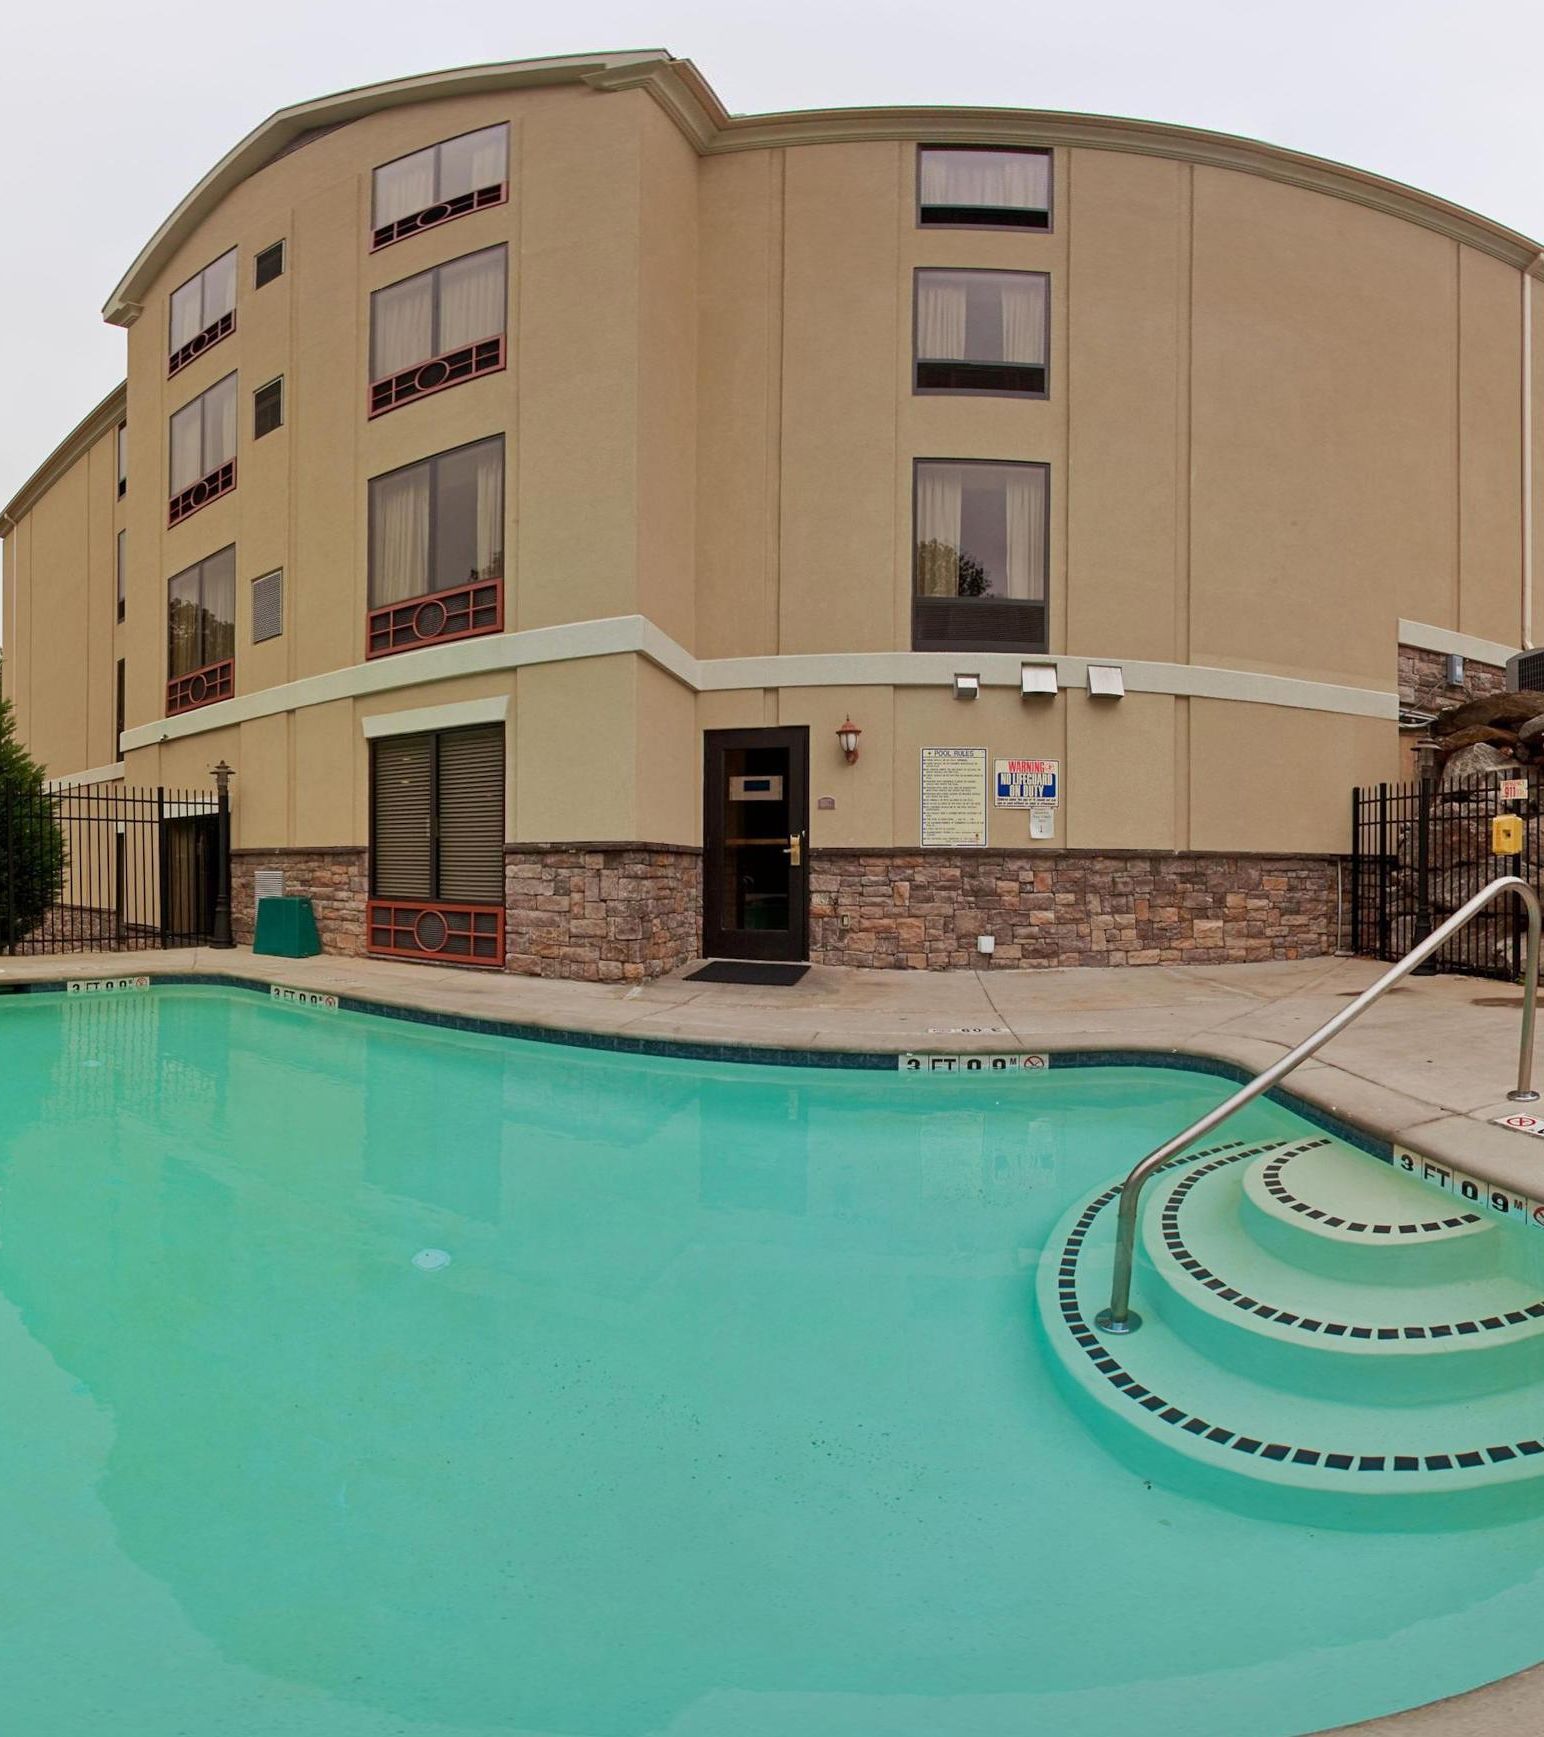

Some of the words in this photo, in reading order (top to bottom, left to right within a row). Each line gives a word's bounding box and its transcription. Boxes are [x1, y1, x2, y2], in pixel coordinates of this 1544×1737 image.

[1008, 761, 1045, 773] WARNING
[1001, 773, 1012, 785] NO
[1013, 773, 1053, 786] LIFEGUARD
[1009, 785, 1021, 797] ON
[1023, 785, 1044, 797] DUTY
[1504, 786, 1516, 798] 911
[931, 1058, 957, 1071] FT
[1401, 1153, 1414, 1172] 3
[1424, 1162, 1450, 1188] FT
